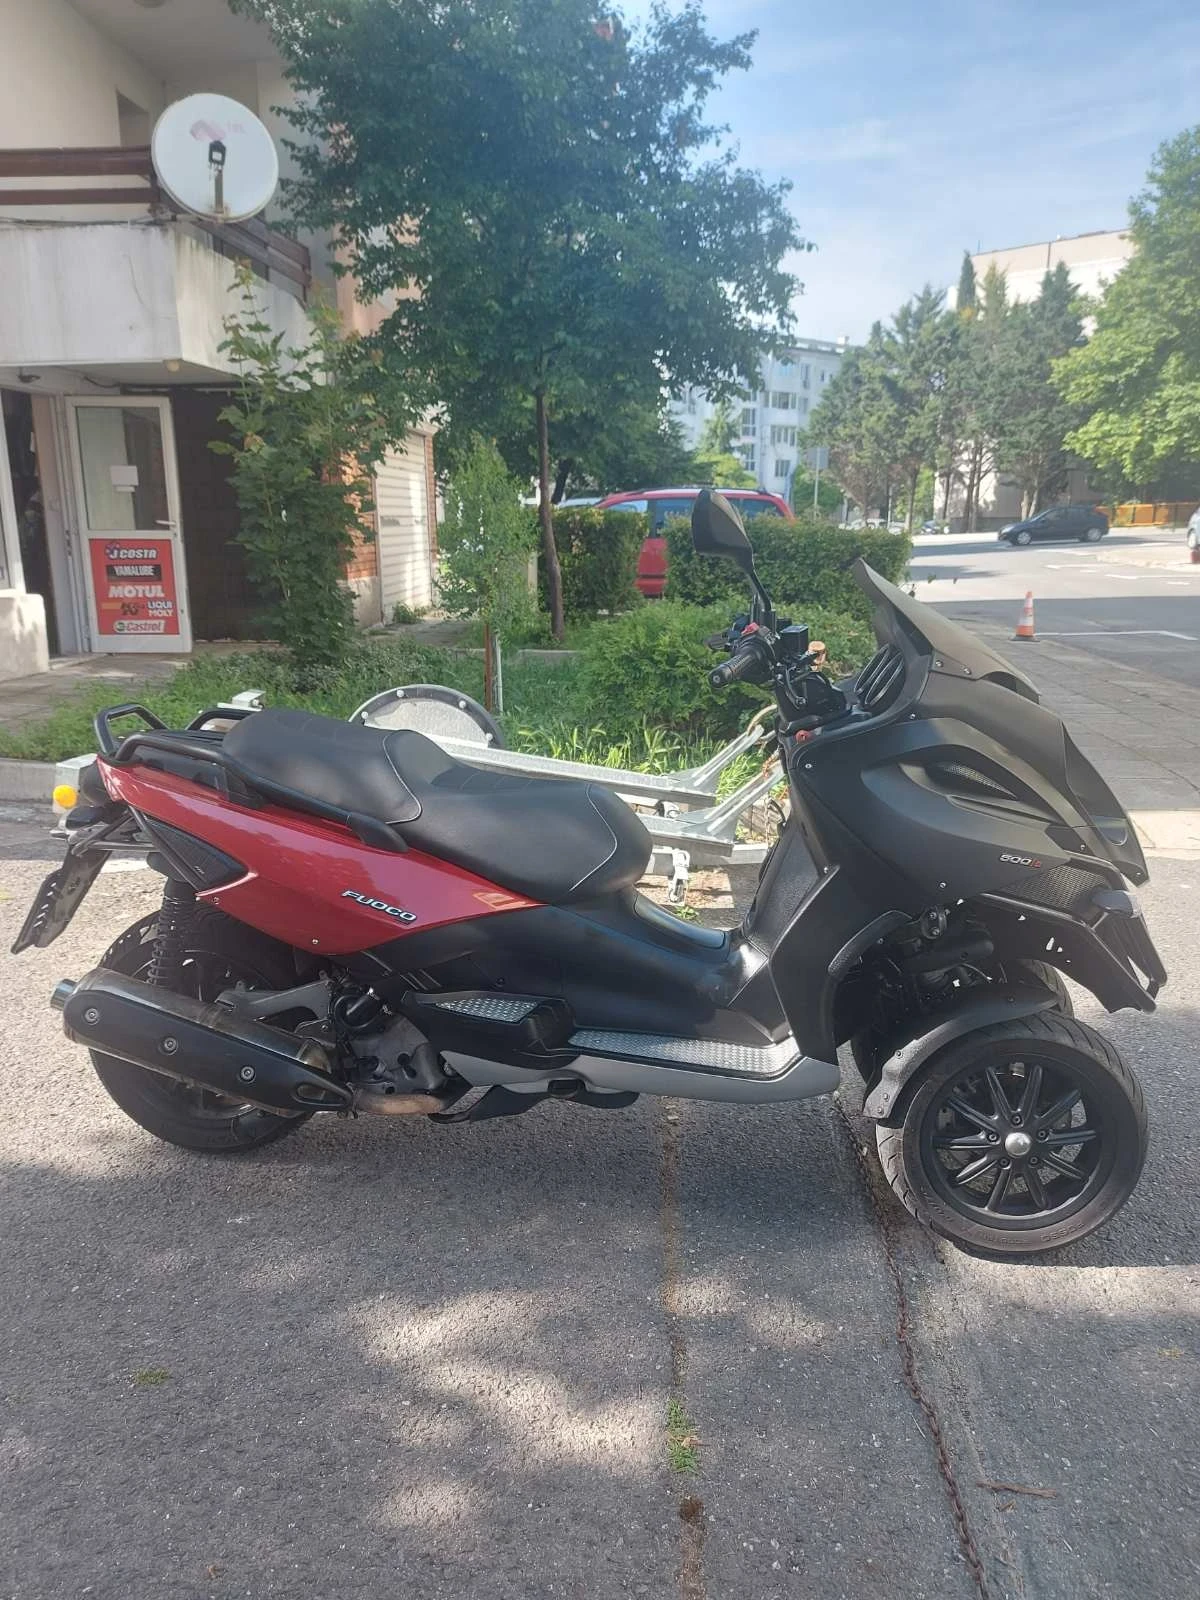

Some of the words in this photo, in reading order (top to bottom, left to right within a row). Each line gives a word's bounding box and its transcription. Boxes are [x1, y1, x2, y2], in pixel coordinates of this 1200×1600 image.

[108, 584, 165, 598] MOTUL
[147, 600, 173, 609] LIQUI
[148, 609, 173, 617] MOLY
[127, 621, 161, 631] Castrol
[341, 890, 417, 921] FUOCO
